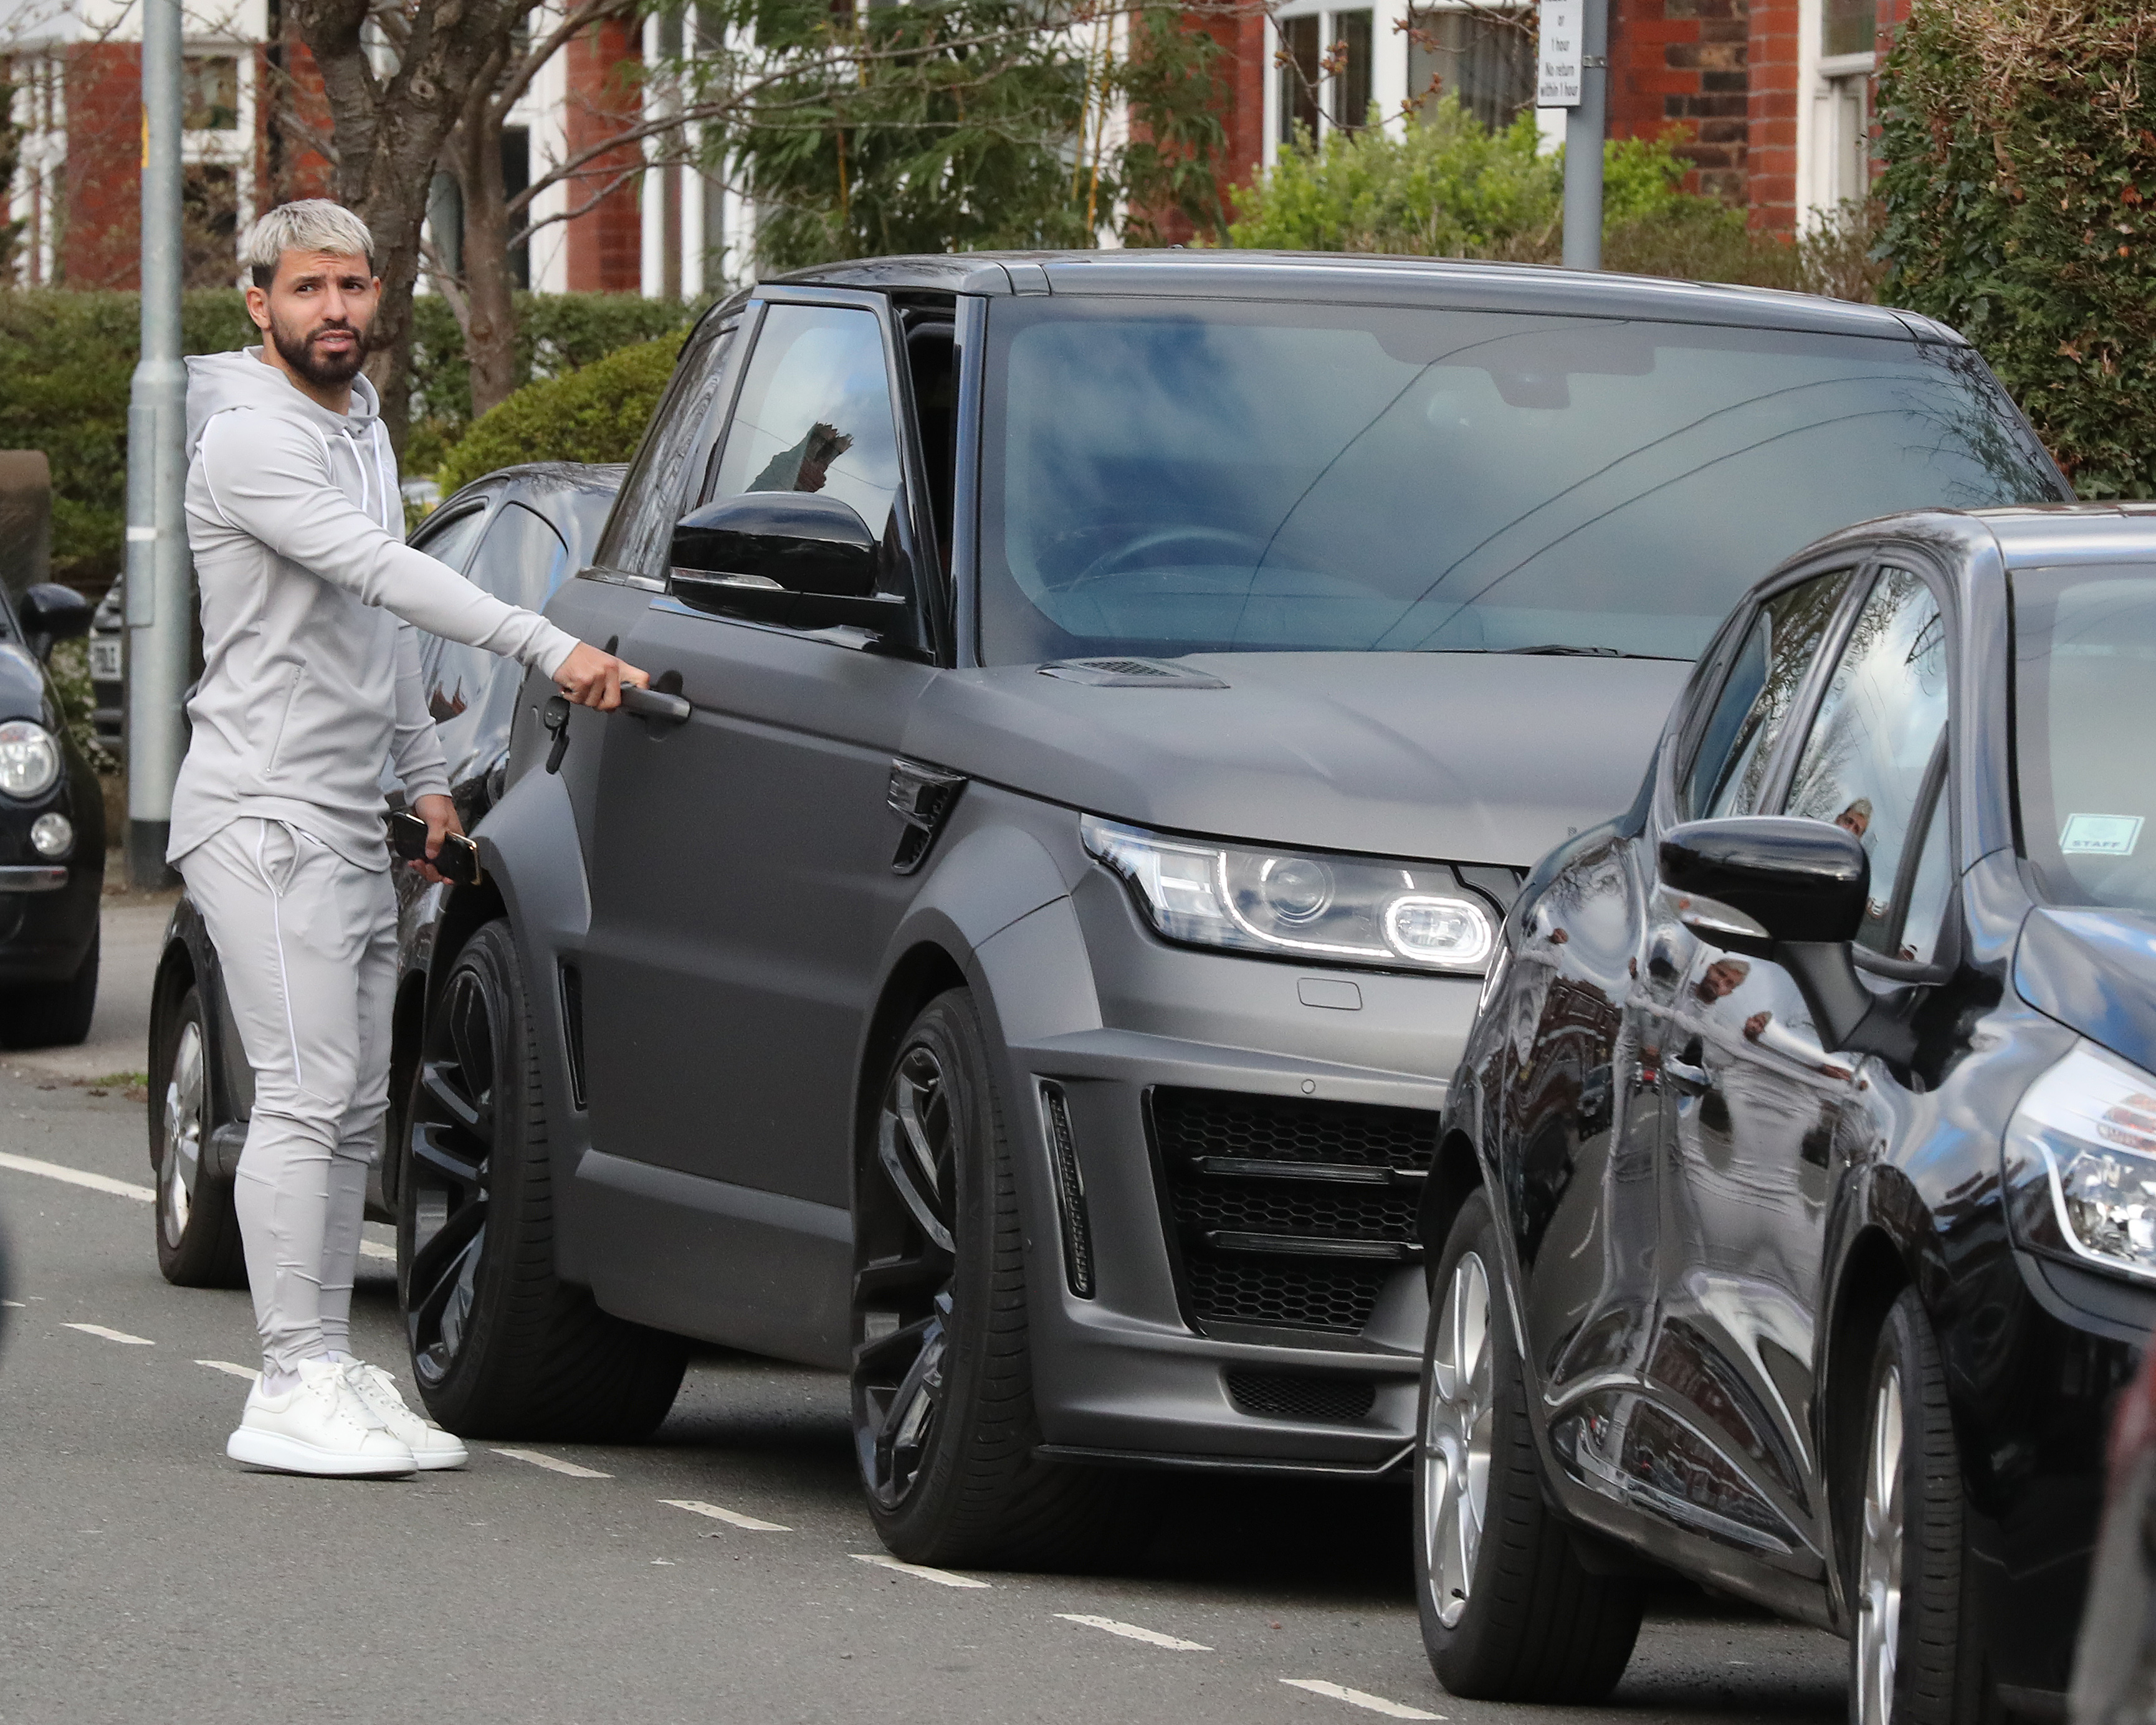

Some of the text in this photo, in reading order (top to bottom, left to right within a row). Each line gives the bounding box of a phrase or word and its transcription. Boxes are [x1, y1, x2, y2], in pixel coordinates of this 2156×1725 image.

[1557, 37, 1570, 52] hour
[1545, 62, 1574, 77] No return
[1540, 82, 1558, 97] within
[1565, 82, 1578, 97] hour
